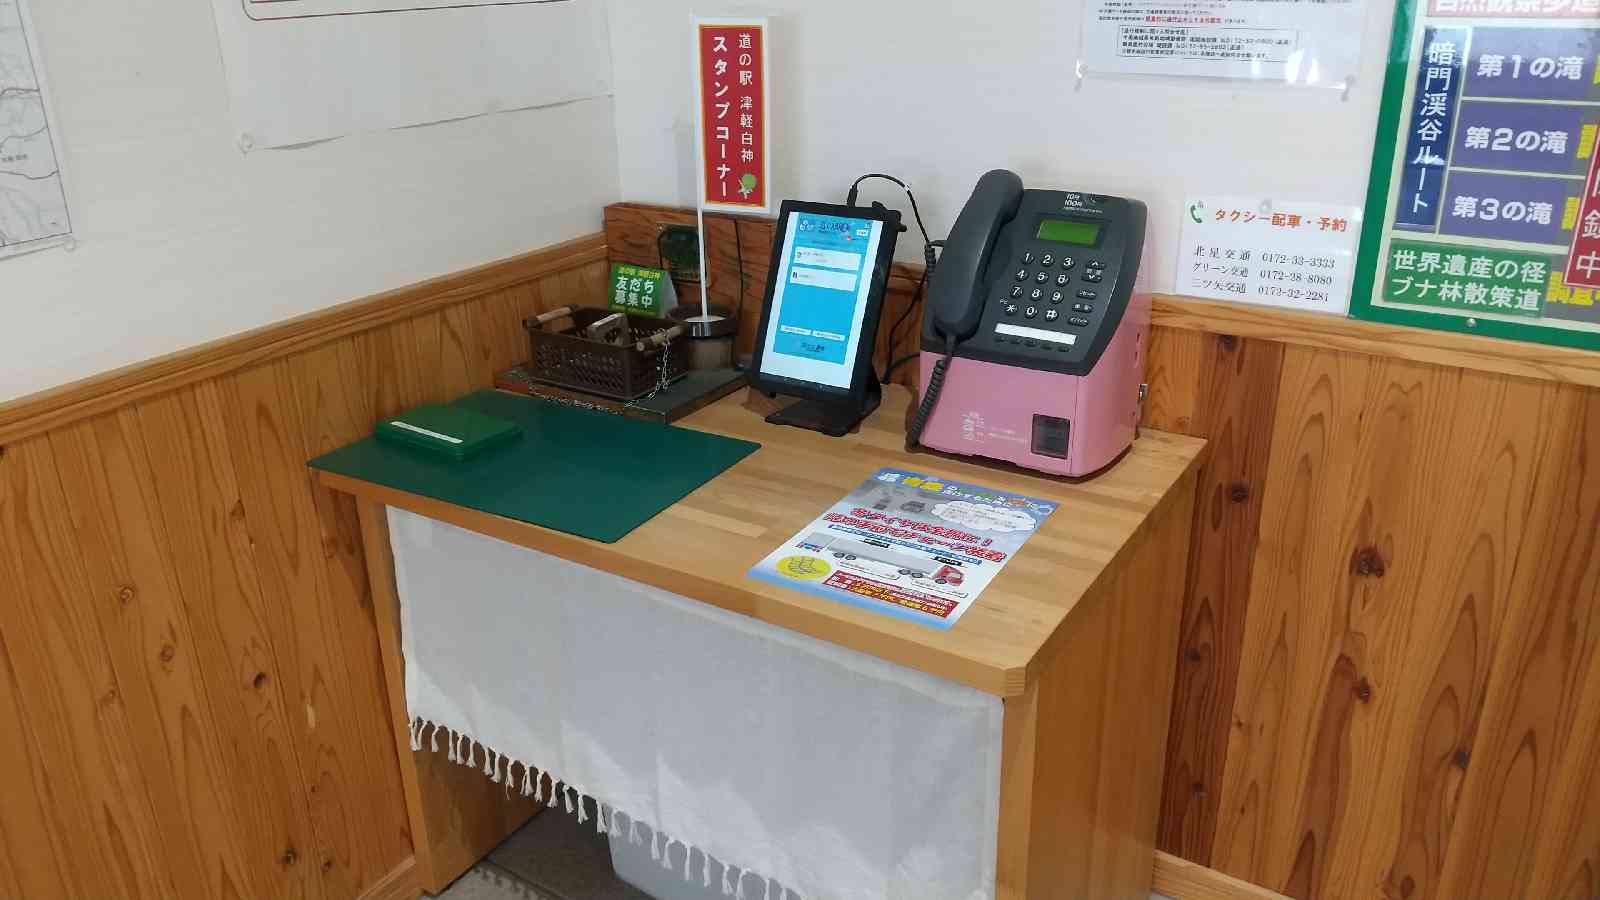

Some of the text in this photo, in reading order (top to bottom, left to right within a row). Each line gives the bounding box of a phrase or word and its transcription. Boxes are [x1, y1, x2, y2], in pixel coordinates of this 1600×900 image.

[738, 33, 754, 163] 道の駅 津軽白神
[713, 36, 731, 197] スタンプコーナー
[1412, 41, 1456, 213] 暗門渓谷ルート
[1465, 126, 1568, 154] 第2の滝
[1215, 208, 1348, 232] タクシー配車・予約
[1451, 196, 1553, 225] 第3の滝
[1393, 249, 1546, 283] 世界遺産の径
[615, 289, 653, 309] 募集中
[616, 276, 655, 294] 友だち
[1392, 276, 1541, 311] ブナ林散策道
